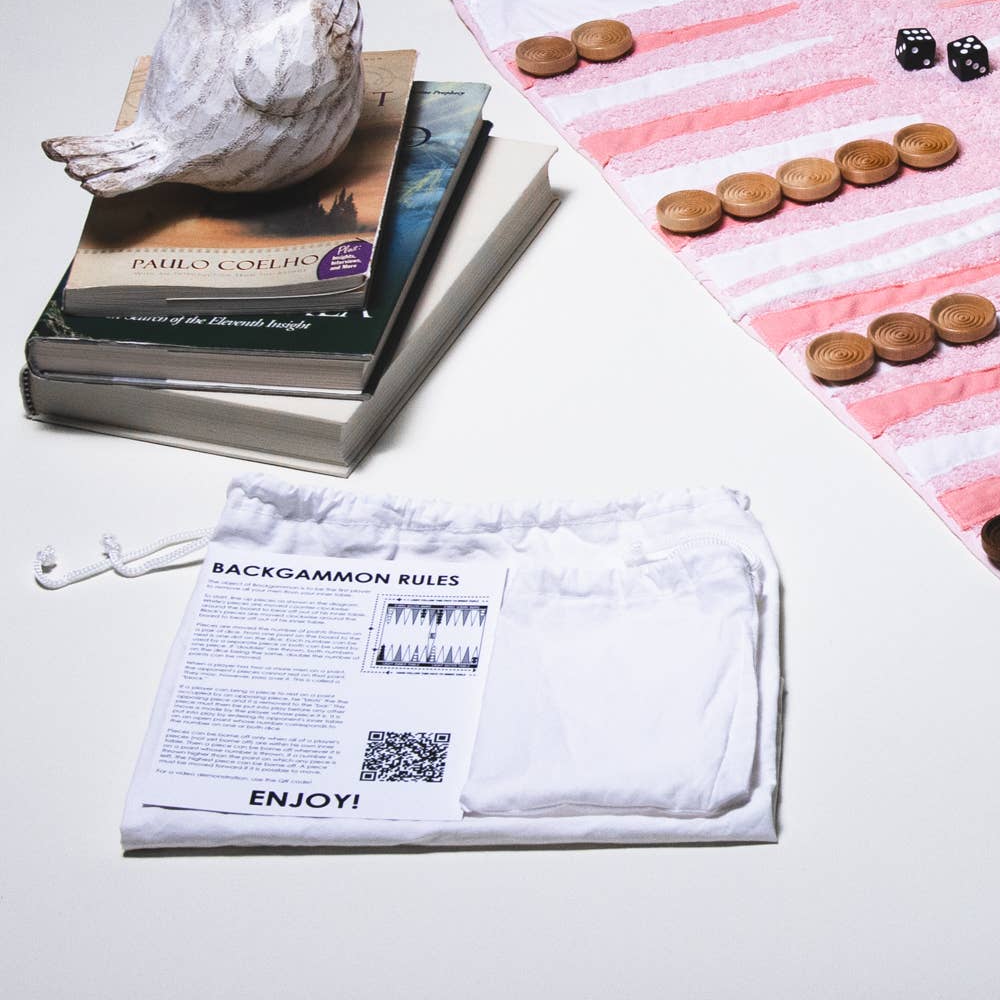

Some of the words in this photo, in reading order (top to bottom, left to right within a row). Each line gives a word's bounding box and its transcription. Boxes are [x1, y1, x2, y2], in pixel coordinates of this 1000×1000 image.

[132, 258, 210, 270] PAULO
[218, 254, 319, 271] COELHO
[185, 316, 207, 325] the
[208, 316, 265, 327] Eleventh
[266, 319, 312, 331] Insight
[212, 562, 390, 584] BACKGAMMON
[398, 574, 460, 586] RULES
[249, 790, 360, 809] ENJOY!
